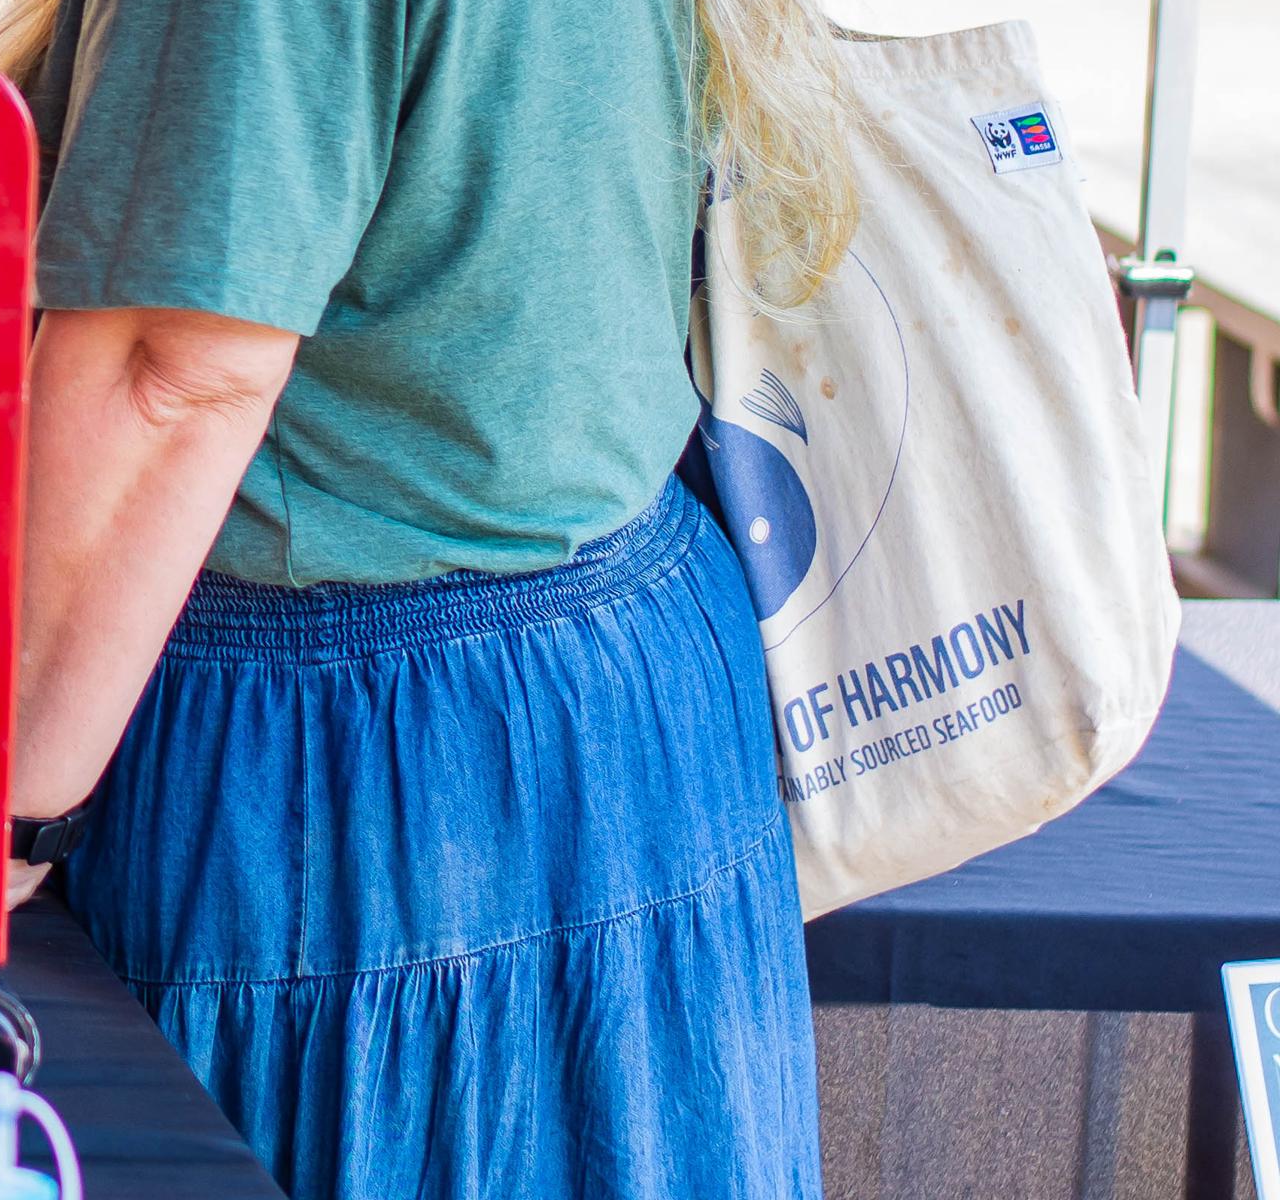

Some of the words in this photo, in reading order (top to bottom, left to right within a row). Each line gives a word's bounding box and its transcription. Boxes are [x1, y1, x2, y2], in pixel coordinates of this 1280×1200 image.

[994, 149, 1017, 160] WWF
[1029, 142, 1051, 152] SASSI
[783, 681, 834, 753] OF
[837, 599, 1031, 728] HARMONY
[850, 724, 932, 776] SOURCED
[932, 682, 1023, 745] SEAFOOD
